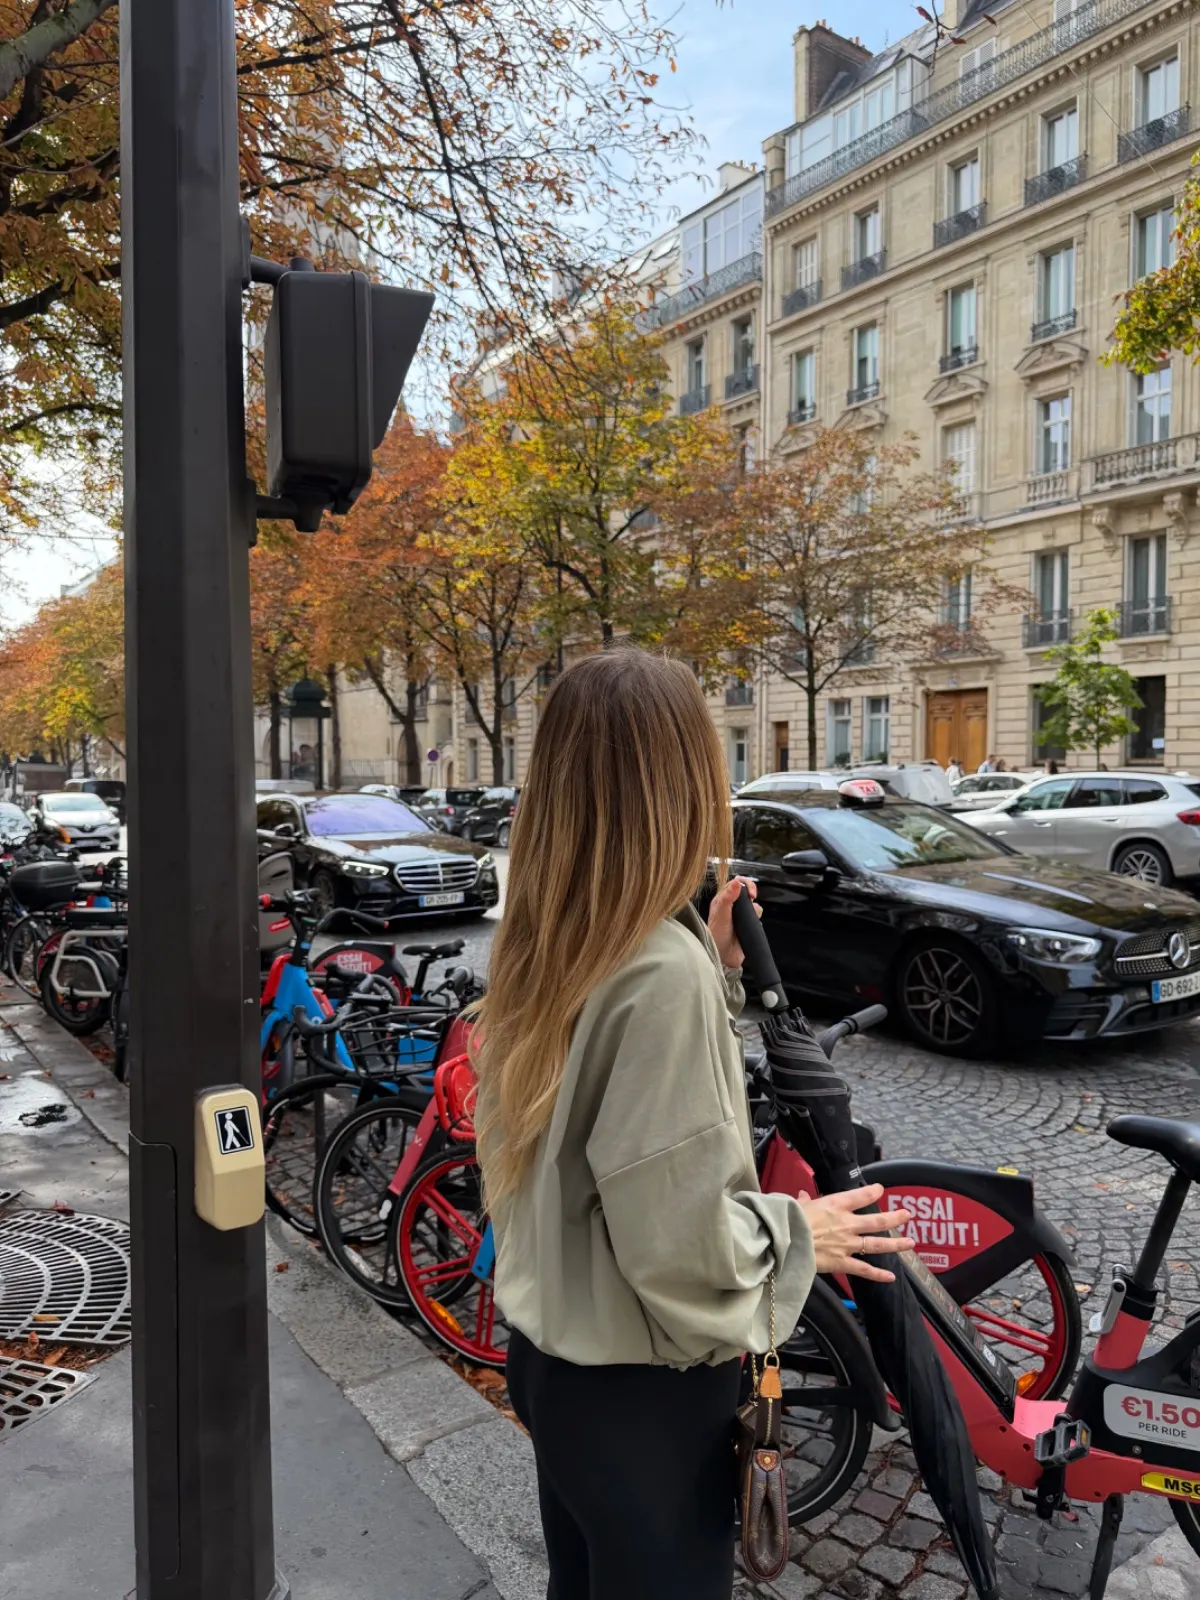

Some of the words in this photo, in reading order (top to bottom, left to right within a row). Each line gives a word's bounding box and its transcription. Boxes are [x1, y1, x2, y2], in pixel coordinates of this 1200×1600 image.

[888, 1194, 953, 1221] ESSAI
[897, 1220, 979, 1247] ATUIT!
[1121, 1395, 1200, 1429] €1.50
[1139, 1421, 1160, 1433] PER
[1161, 1426, 1187, 1439] RIDE
